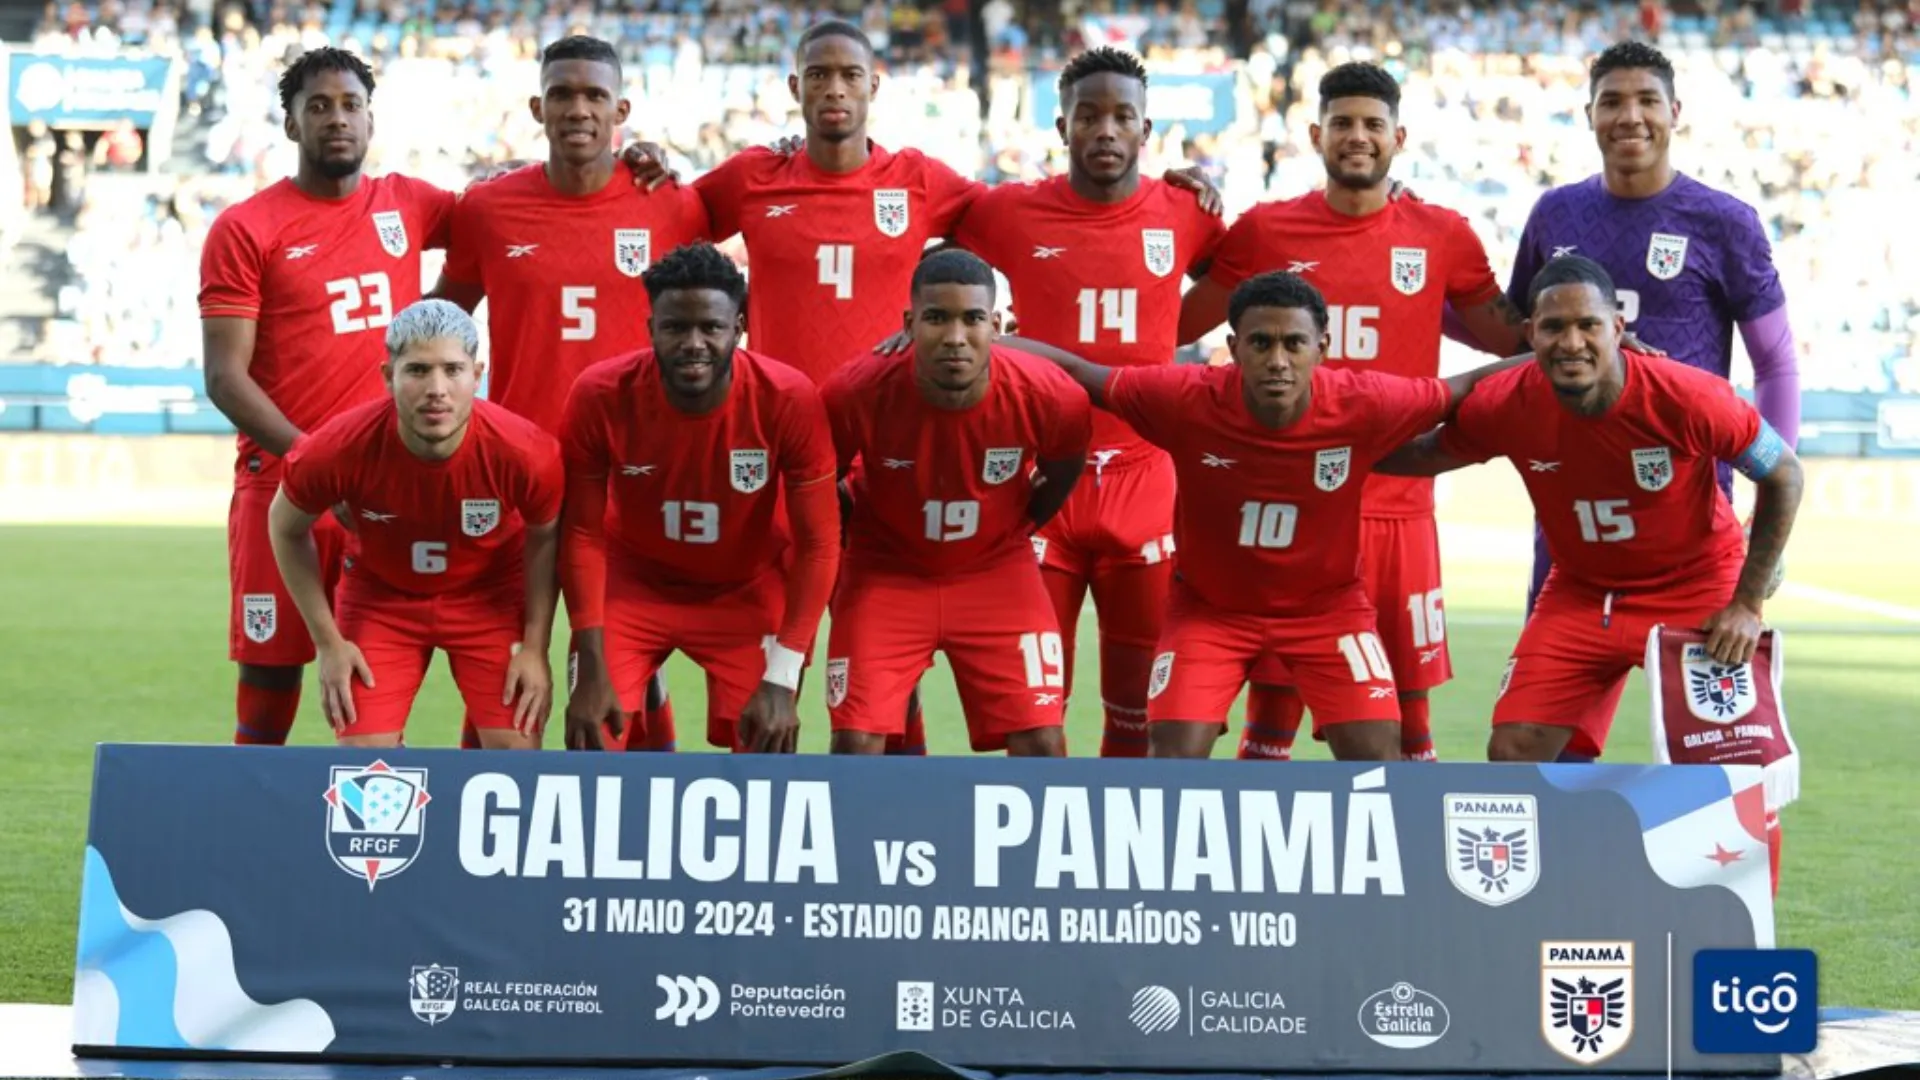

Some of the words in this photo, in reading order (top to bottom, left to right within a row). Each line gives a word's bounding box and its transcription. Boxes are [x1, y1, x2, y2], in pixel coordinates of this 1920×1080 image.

[815, 245, 854, 299] 4
[325, 271, 393, 334] 23
[562, 286, 596, 341] 5
[1077, 289, 1138, 343] 14
[1326, 305, 1381, 360] 16
[661, 500, 720, 543] 13
[923, 500, 980, 542] 19
[1238, 502, 1298, 548] 10
[1574, 499, 1636, 542] 15
[411, 541, 447, 574] 6
[1406, 588, 1444, 648] 16
[1019, 632, 1064, 688] 19
[1338, 632, 1394, 683] 10
[1453, 800, 1527, 815] PANAMÁ
[349, 837, 401, 854] RFGF
[458, 772, 839, 884] GALICIA
[974, 766, 1406, 896] PANAMÁ
[563, 897, 596, 932] 31
[606, 898, 685, 935] MAIO
[694, 900, 775, 936] 2024
[803, 902, 922, 940] ESTADIO
[932, 905, 1050, 943] ABANCA
[1060, 901, 1202, 945] BALAÍDOS
[1230, 911, 1297, 947] VIGO
[463, 998, 521, 1012] GALEGA
[524, 1000, 543, 1013] DE
[547, 997, 604, 1014] FÚTBOL
[464, 981, 502, 995] REAL
[505, 980, 598, 997] FEDERACIÓN
[730, 983, 846, 1003] Deputación
[943, 986, 1025, 1006] XUNTA
[1201, 990, 1286, 1011] GALICIA
[1374, 1001, 1434, 1017] Estrella
[730, 1001, 846, 1019] Pontevedra
[942, 1008, 972, 1028] DE
[980, 1009, 1076, 1030] GALICIA
[1201, 1015, 1307, 1035] CALIDADE
[1376, 1017, 1432, 1033] Galicia
